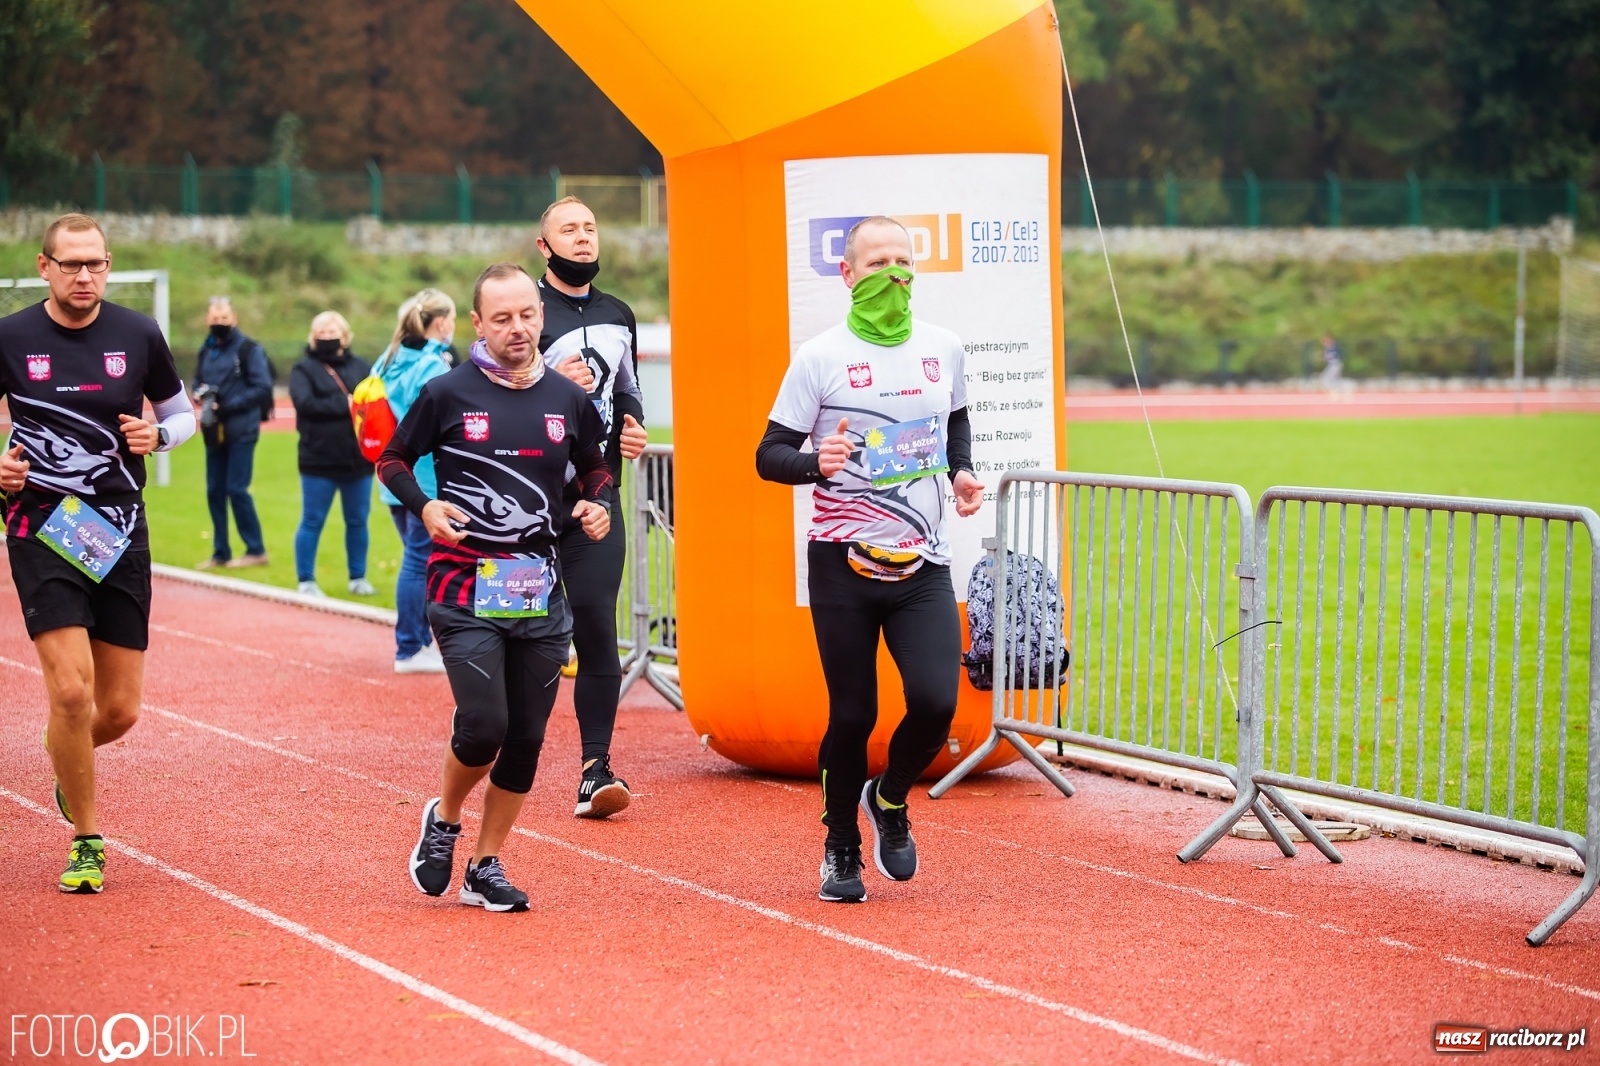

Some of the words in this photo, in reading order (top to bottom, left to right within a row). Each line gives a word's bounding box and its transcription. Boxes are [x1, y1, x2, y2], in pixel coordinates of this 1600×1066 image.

[972, 221, 989, 241] Cíl
[962, 340, 1029, 355] ejestracyjnym
[1006, 370, 1021, 381] bez
[976, 400, 997, 412] 85%
[1000, 402, 1010, 411] ze
[1012, 398, 1043, 410] środków
[996, 429, 1032, 442] Rozwoju
[877, 446, 893, 455] BIEG
[896, 442, 910, 451] DLA
[916, 453, 941, 470] 236
[993, 463, 1004, 471] ze
[1007, 459, 1041, 470] środków
[63, 515, 78, 528] BIEG
[77, 526, 91, 538] DLA
[78, 551, 102, 572] 025
[506, 580, 520, 588] DLA
[522, 598, 542, 611] 218
